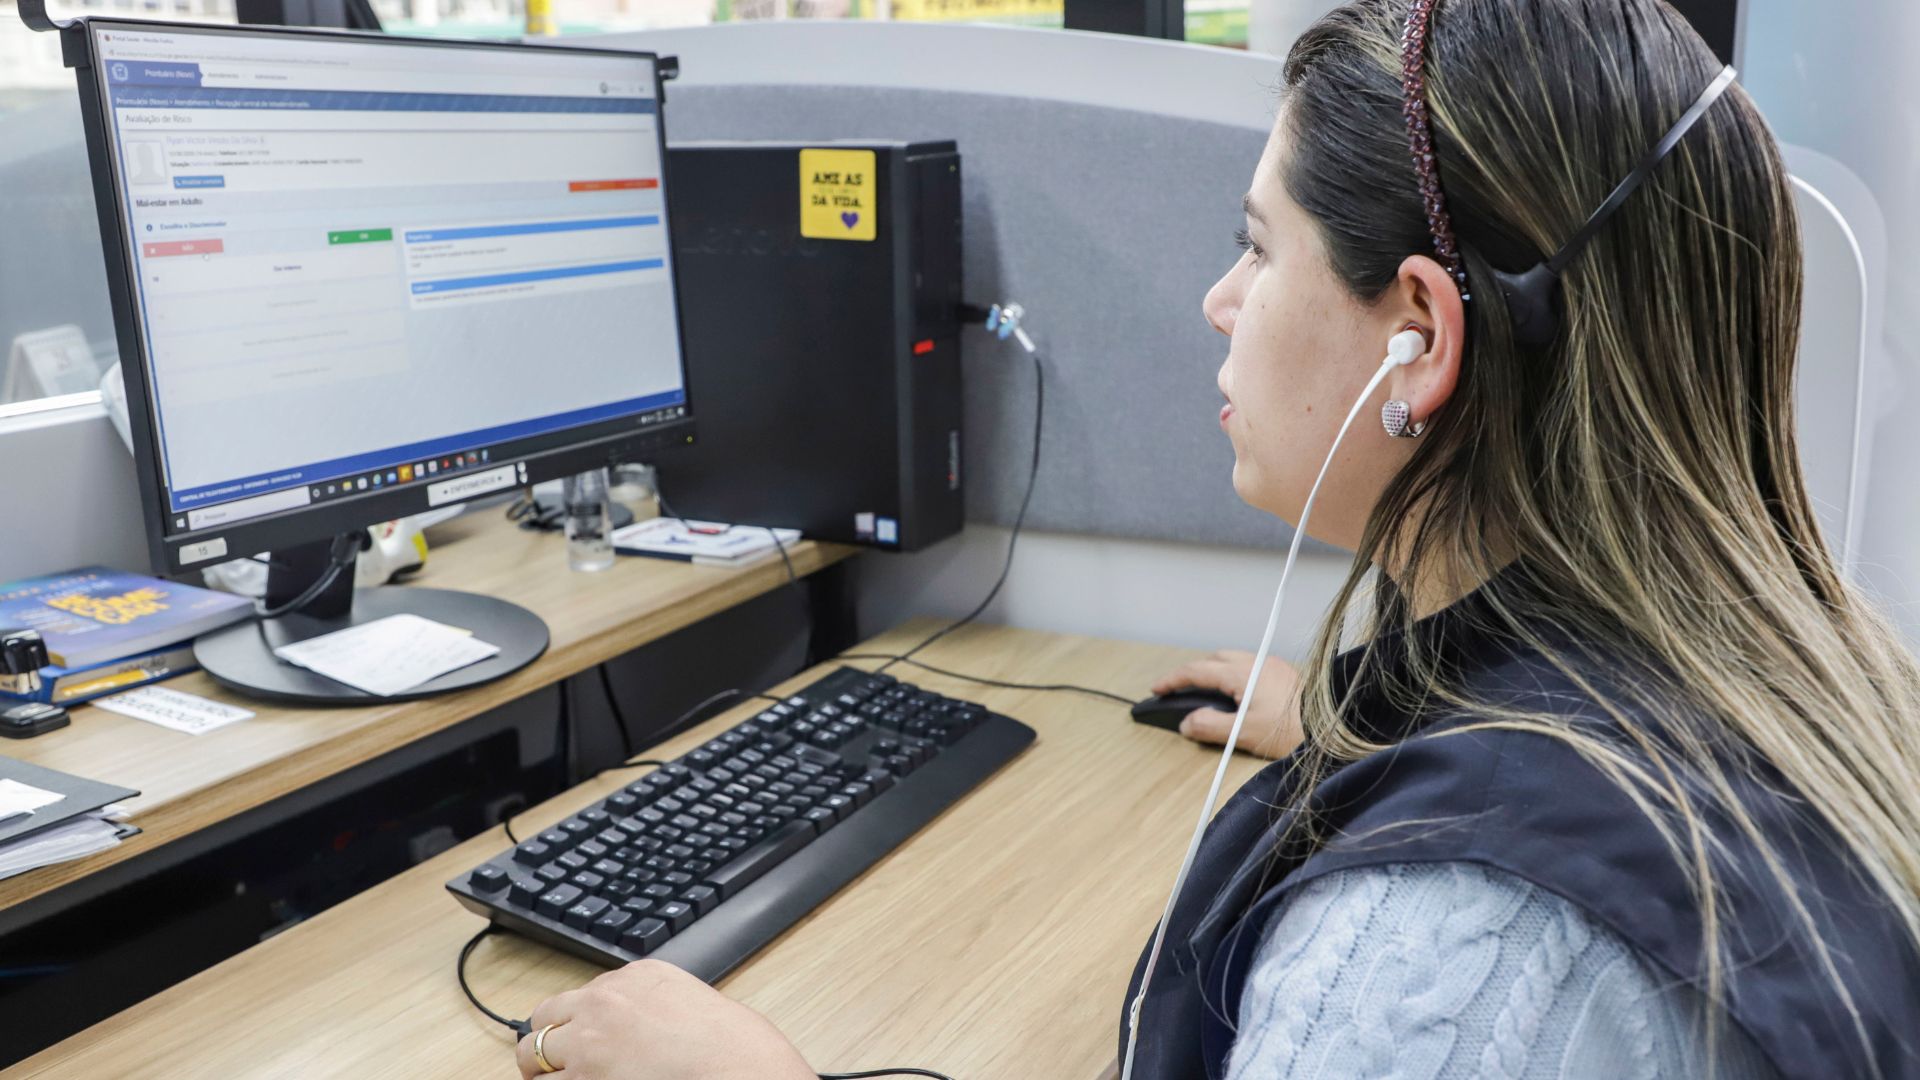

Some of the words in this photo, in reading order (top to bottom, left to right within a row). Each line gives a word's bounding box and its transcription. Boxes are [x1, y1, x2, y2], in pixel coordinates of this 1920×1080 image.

[125, 113, 160, 124] Avaliação
[161, 115, 171, 123] de
[173, 114, 192, 123] Risco
[844, 173, 863, 186] AS
[181, 198, 203, 206] Adulto
